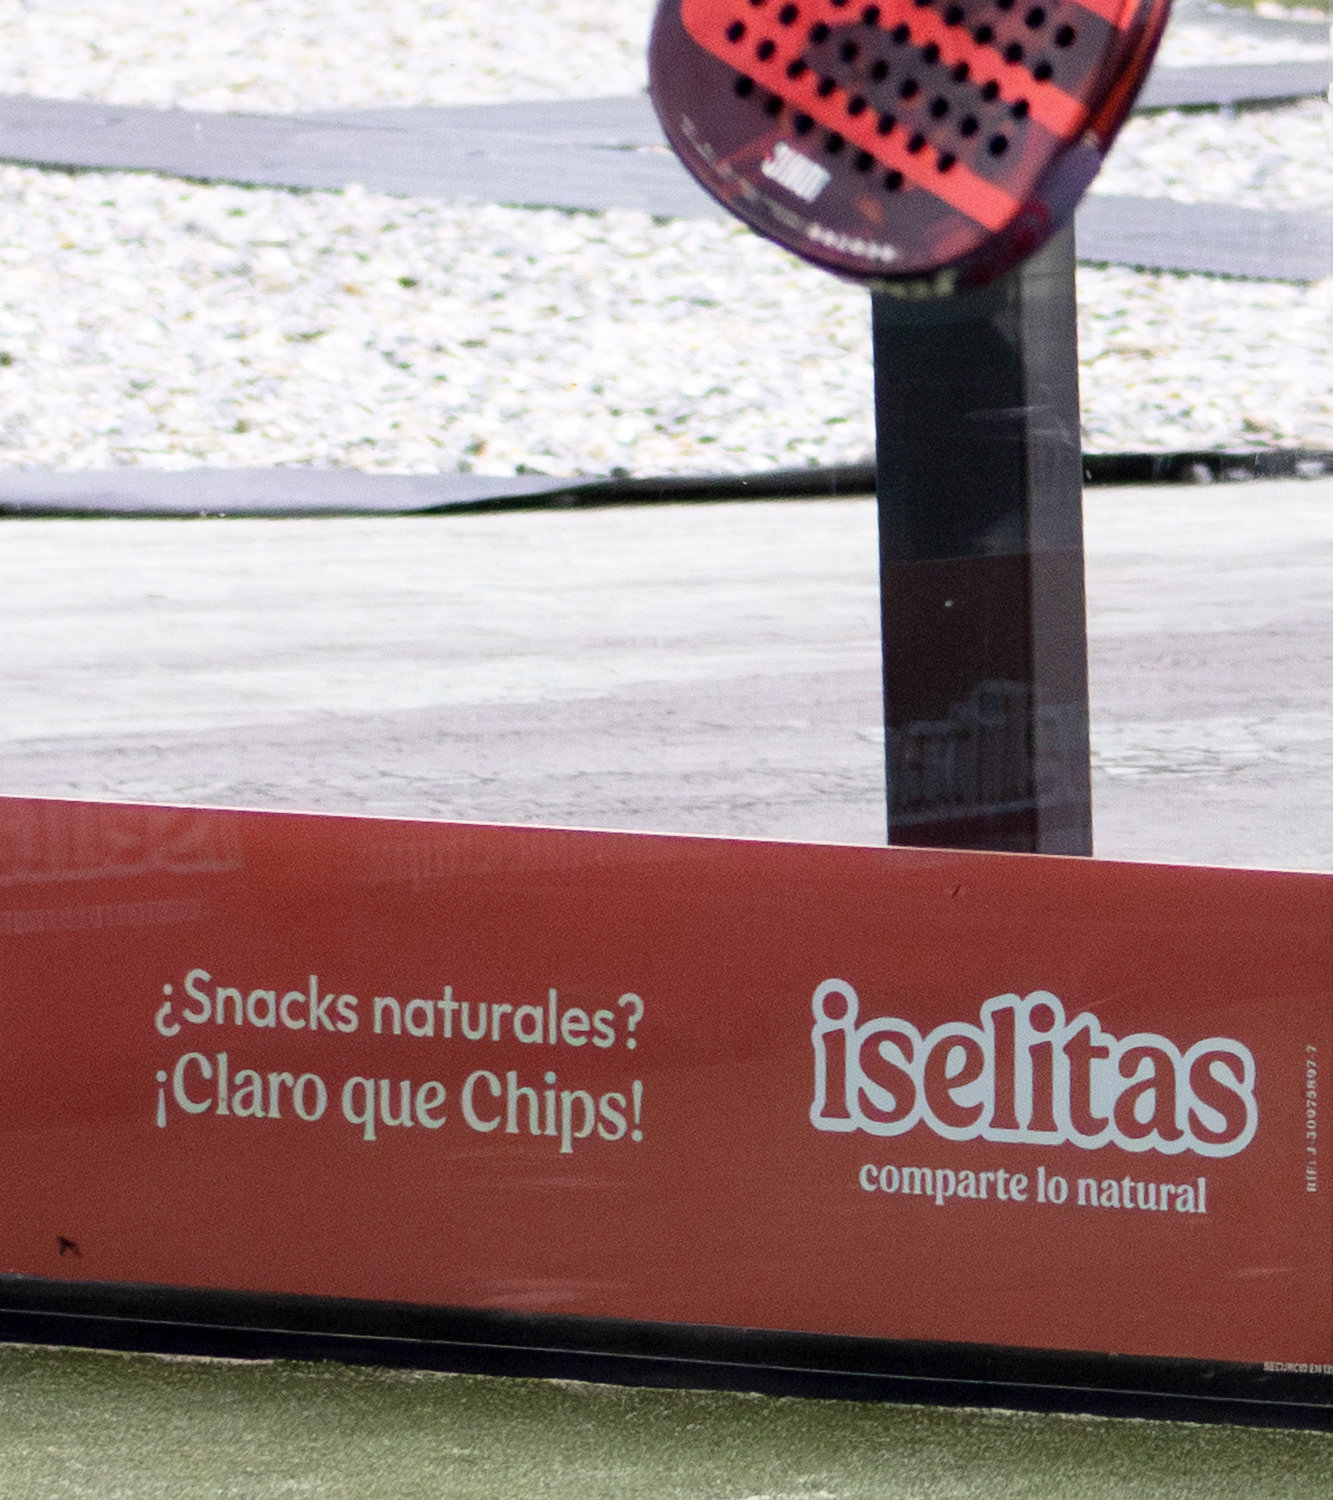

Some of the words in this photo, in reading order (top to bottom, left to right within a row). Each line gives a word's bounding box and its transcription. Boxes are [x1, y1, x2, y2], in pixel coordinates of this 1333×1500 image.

[156, 969, 358, 1036] ¿Snacks
[374, 986, 643, 1049] naturales?
[157, 1053, 327, 1127] ¡Claro
[342, 1077, 445, 1140] que
[462, 1071, 642, 1153] Chips!
[810, 979, 1258, 1158] iselitas
[859, 1164, 1028, 1205] comparte
[1038, 1166, 1068, 1204] lo
[1077, 1168, 1207, 1214] natural
